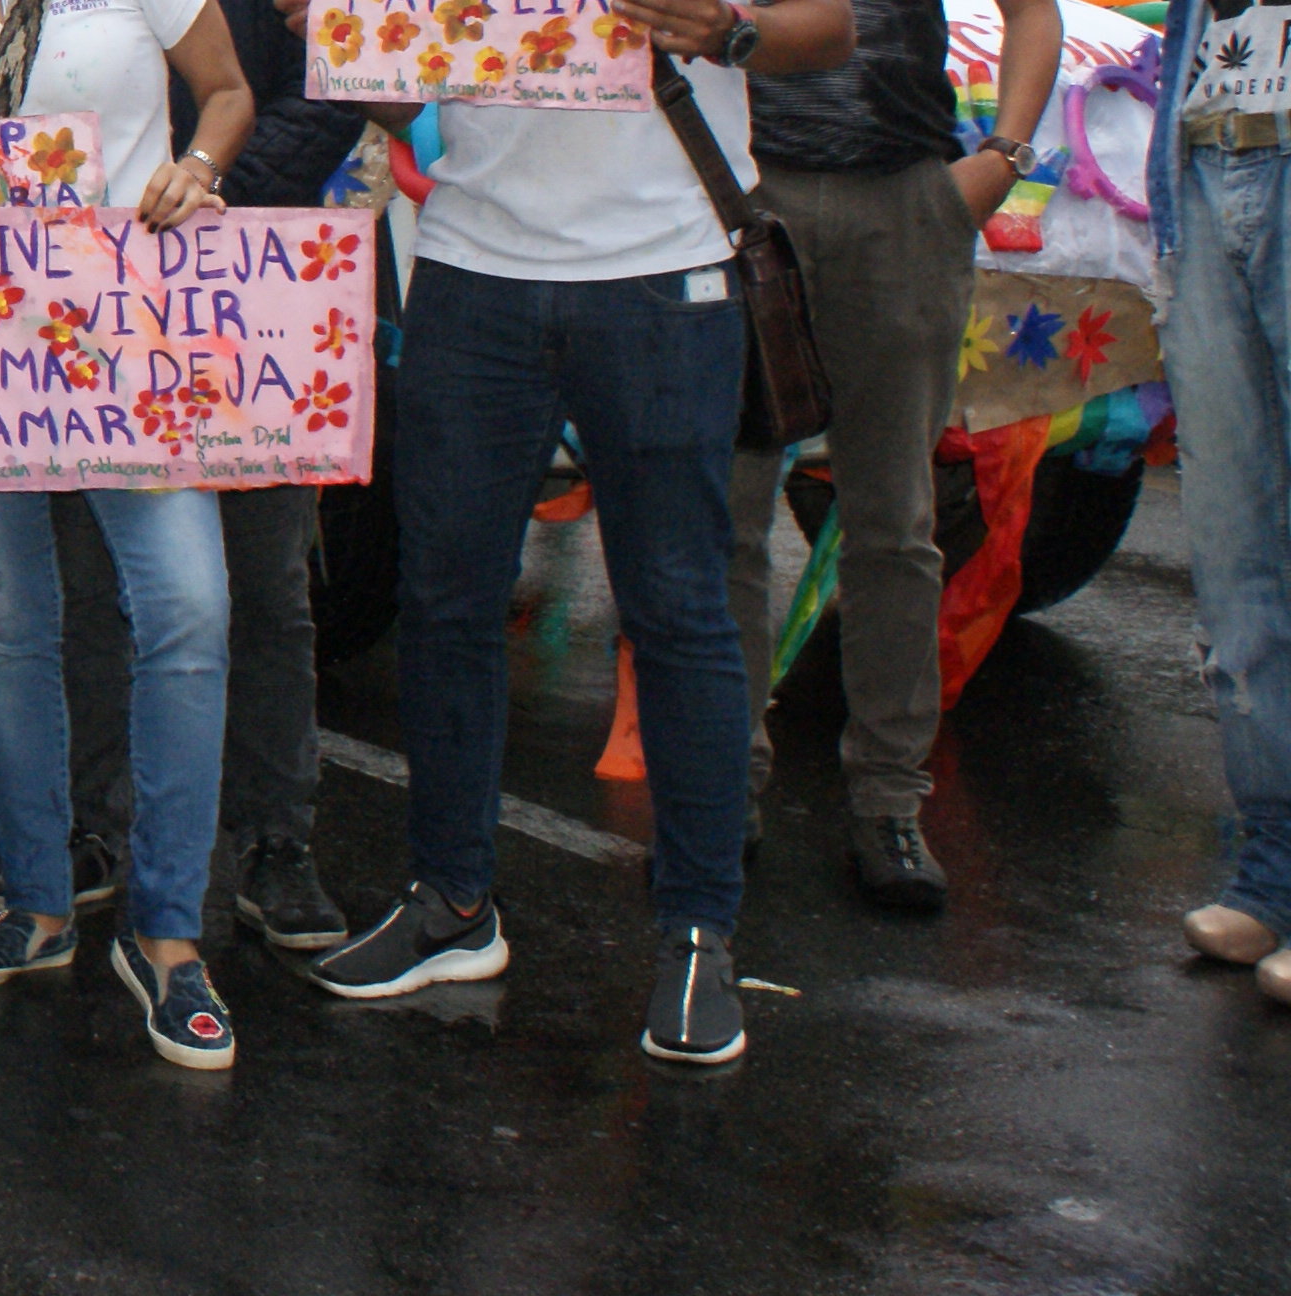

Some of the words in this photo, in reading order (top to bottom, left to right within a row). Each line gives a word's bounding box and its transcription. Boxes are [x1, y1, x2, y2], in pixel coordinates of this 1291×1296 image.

[101, 218, 132, 284] Y
[157, 224, 298, 284] DEJA
[98, 345, 124, 395] Y
[147, 349, 298, 408] DEJA
[45, 455, 66, 477] de
[272, 454, 288, 478] de
